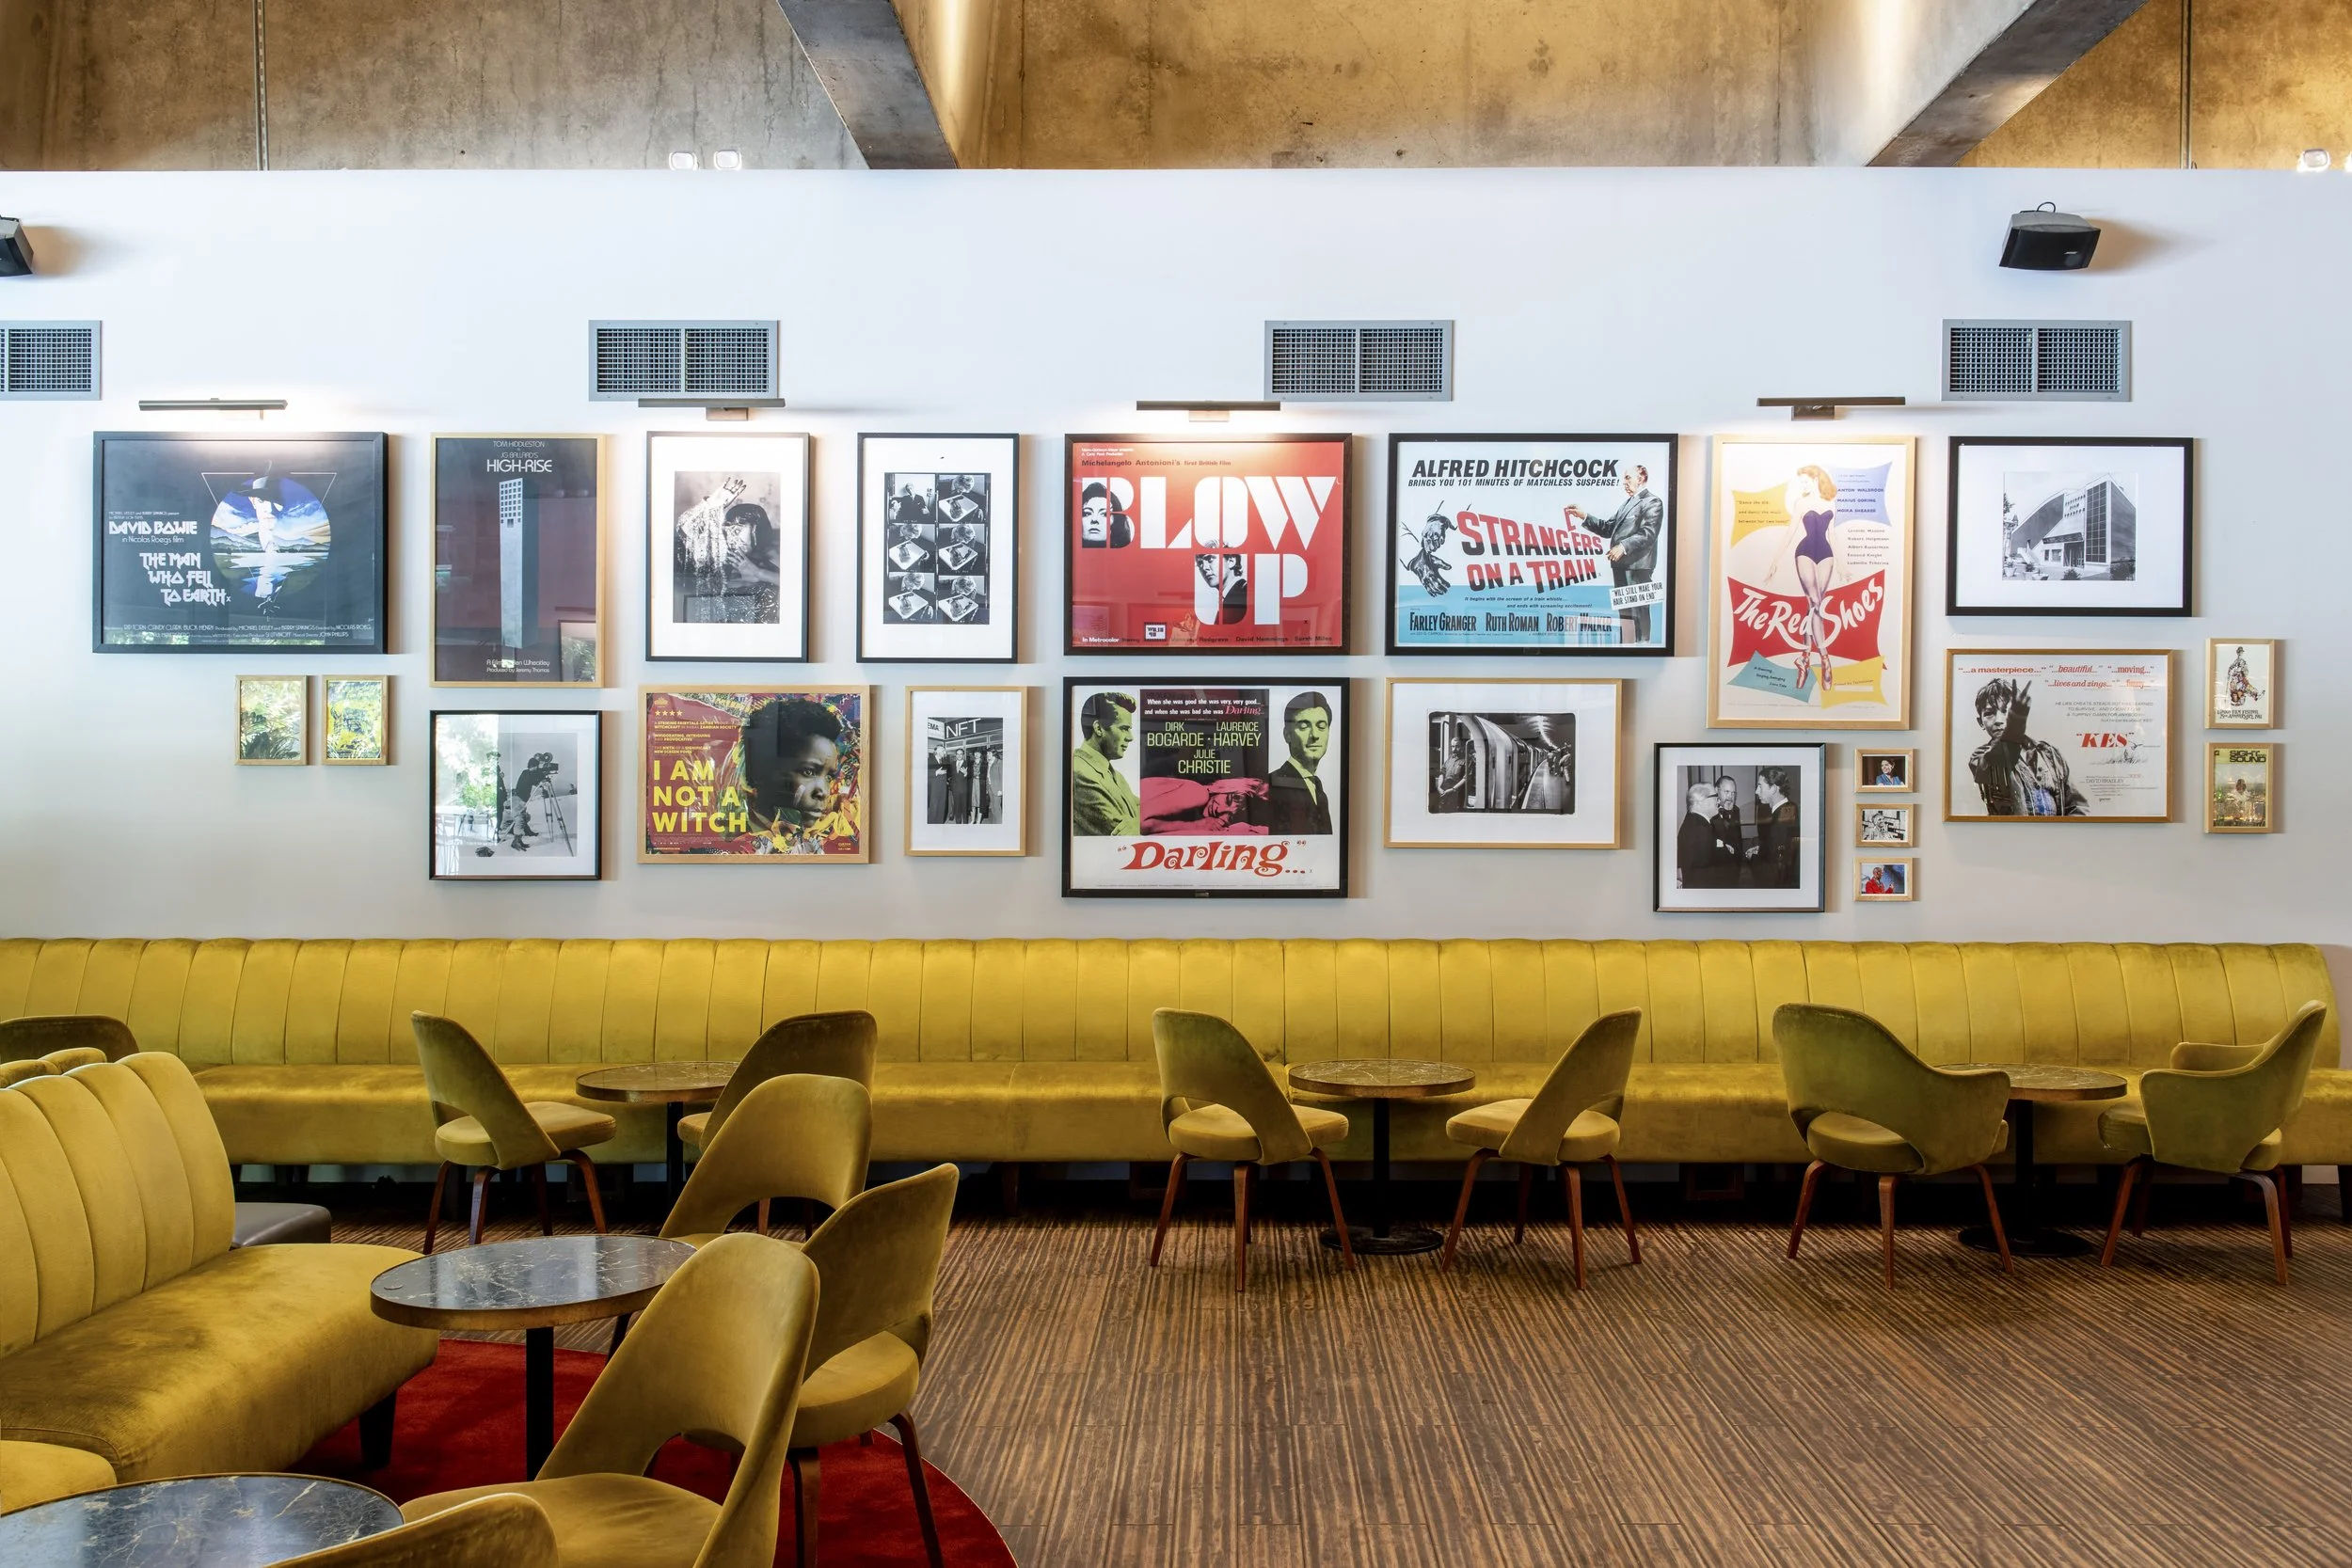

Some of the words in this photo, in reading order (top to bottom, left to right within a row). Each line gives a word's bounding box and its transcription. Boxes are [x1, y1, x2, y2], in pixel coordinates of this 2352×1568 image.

[486, 459, 553, 472] HIGH-RISE
[1411, 459, 1490, 478] ALFRED
[1495, 459, 1619, 478] HITCHCOCK
[1457, 479, 1471, 487] 101
[1082, 476, 1337, 551] BLOW
[109, 521, 152, 534] DAVID
[154, 521, 198, 534] BOWIE
[1456, 511, 1604, 556] STRANGERS
[139, 553, 167, 570] THE
[167, 553, 201, 569] MAN
[148, 571, 185, 587] WHO
[186, 571, 214, 589] FELL
[1466, 562, 1503, 592] ON
[1509, 562, 1524, 585] A
[1526, 559, 1597, 594] TRAIN
[1195, 553, 1309, 626] UP
[1626, 587, 1638, 595] STILL
[1638, 584, 1650, 593] MAKE
[1651, 582, 1663, 591] YOUR
[160, 589, 182, 607] TO
[183, 589, 226, 607] EARTH
[1613, 596, 1624, 606] HAIR
[1625, 595, 1638, 604] STAND
[1639, 594, 1645, 602] ON
[1409, 612, 1438, 631] FARLEY
[1439, 612, 1477, 631] GRANGER
[1486, 612, 1507, 632] RUTH
[1509, 612, 1539, 632] ROMAN
[1547, 612, 1579, 632] ROBERT
[1581, 612, 1613, 632] WALKER
[1734, 588, 1769, 630] The
[1762, 600, 1818, 650] Red
[1820, 578, 1883, 650] Shoes
[946, 718, 981, 738] NFT
[1165, 722, 1184, 732] DIRK
[1216, 722, 1259, 732] LAURENCE
[1147, 733, 1204, 747] BOGARDE
[1214, 733, 1262, 747] HARVEY
[1194, 750, 1216, 759] JULIE
[654, 760, 660, 781] I
[670, 760, 715, 781] AM
[1178, 760, 1231, 774] CHRISTIE
[654, 786, 714, 807] NOT
[722, 786, 741, 807] A
[652, 813, 747, 832] WITCH
